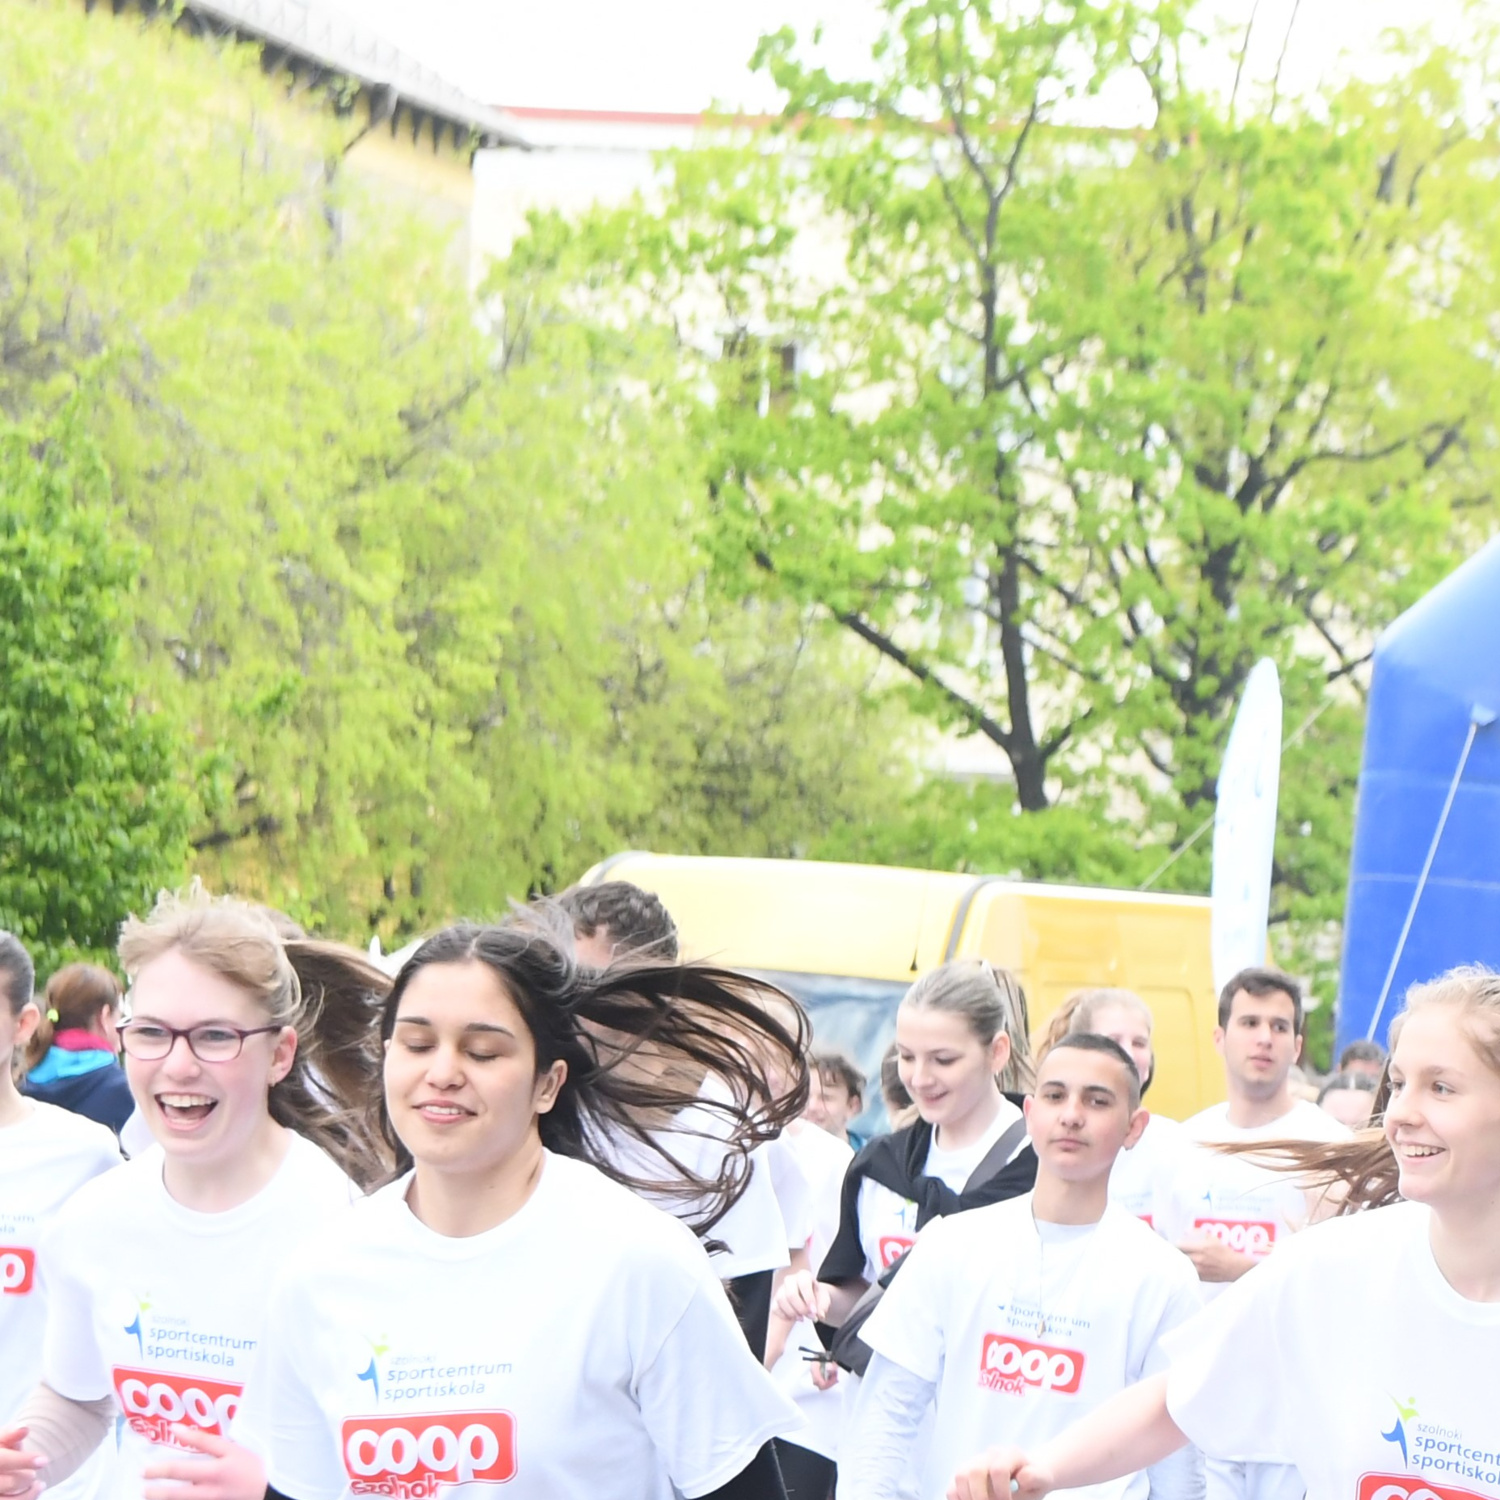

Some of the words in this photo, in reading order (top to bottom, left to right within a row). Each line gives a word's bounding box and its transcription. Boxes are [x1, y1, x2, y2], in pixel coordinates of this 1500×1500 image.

[149, 1327, 258, 1351] sportcentrum
[146, 1344, 235, 1367] sportiskola
[387, 1362, 513, 1383] sportcentrum
[384, 1380, 486, 1402] sportiskola
[1417, 1422, 1463, 1440] szolnoki
[347, 1423, 500, 1482] coop
